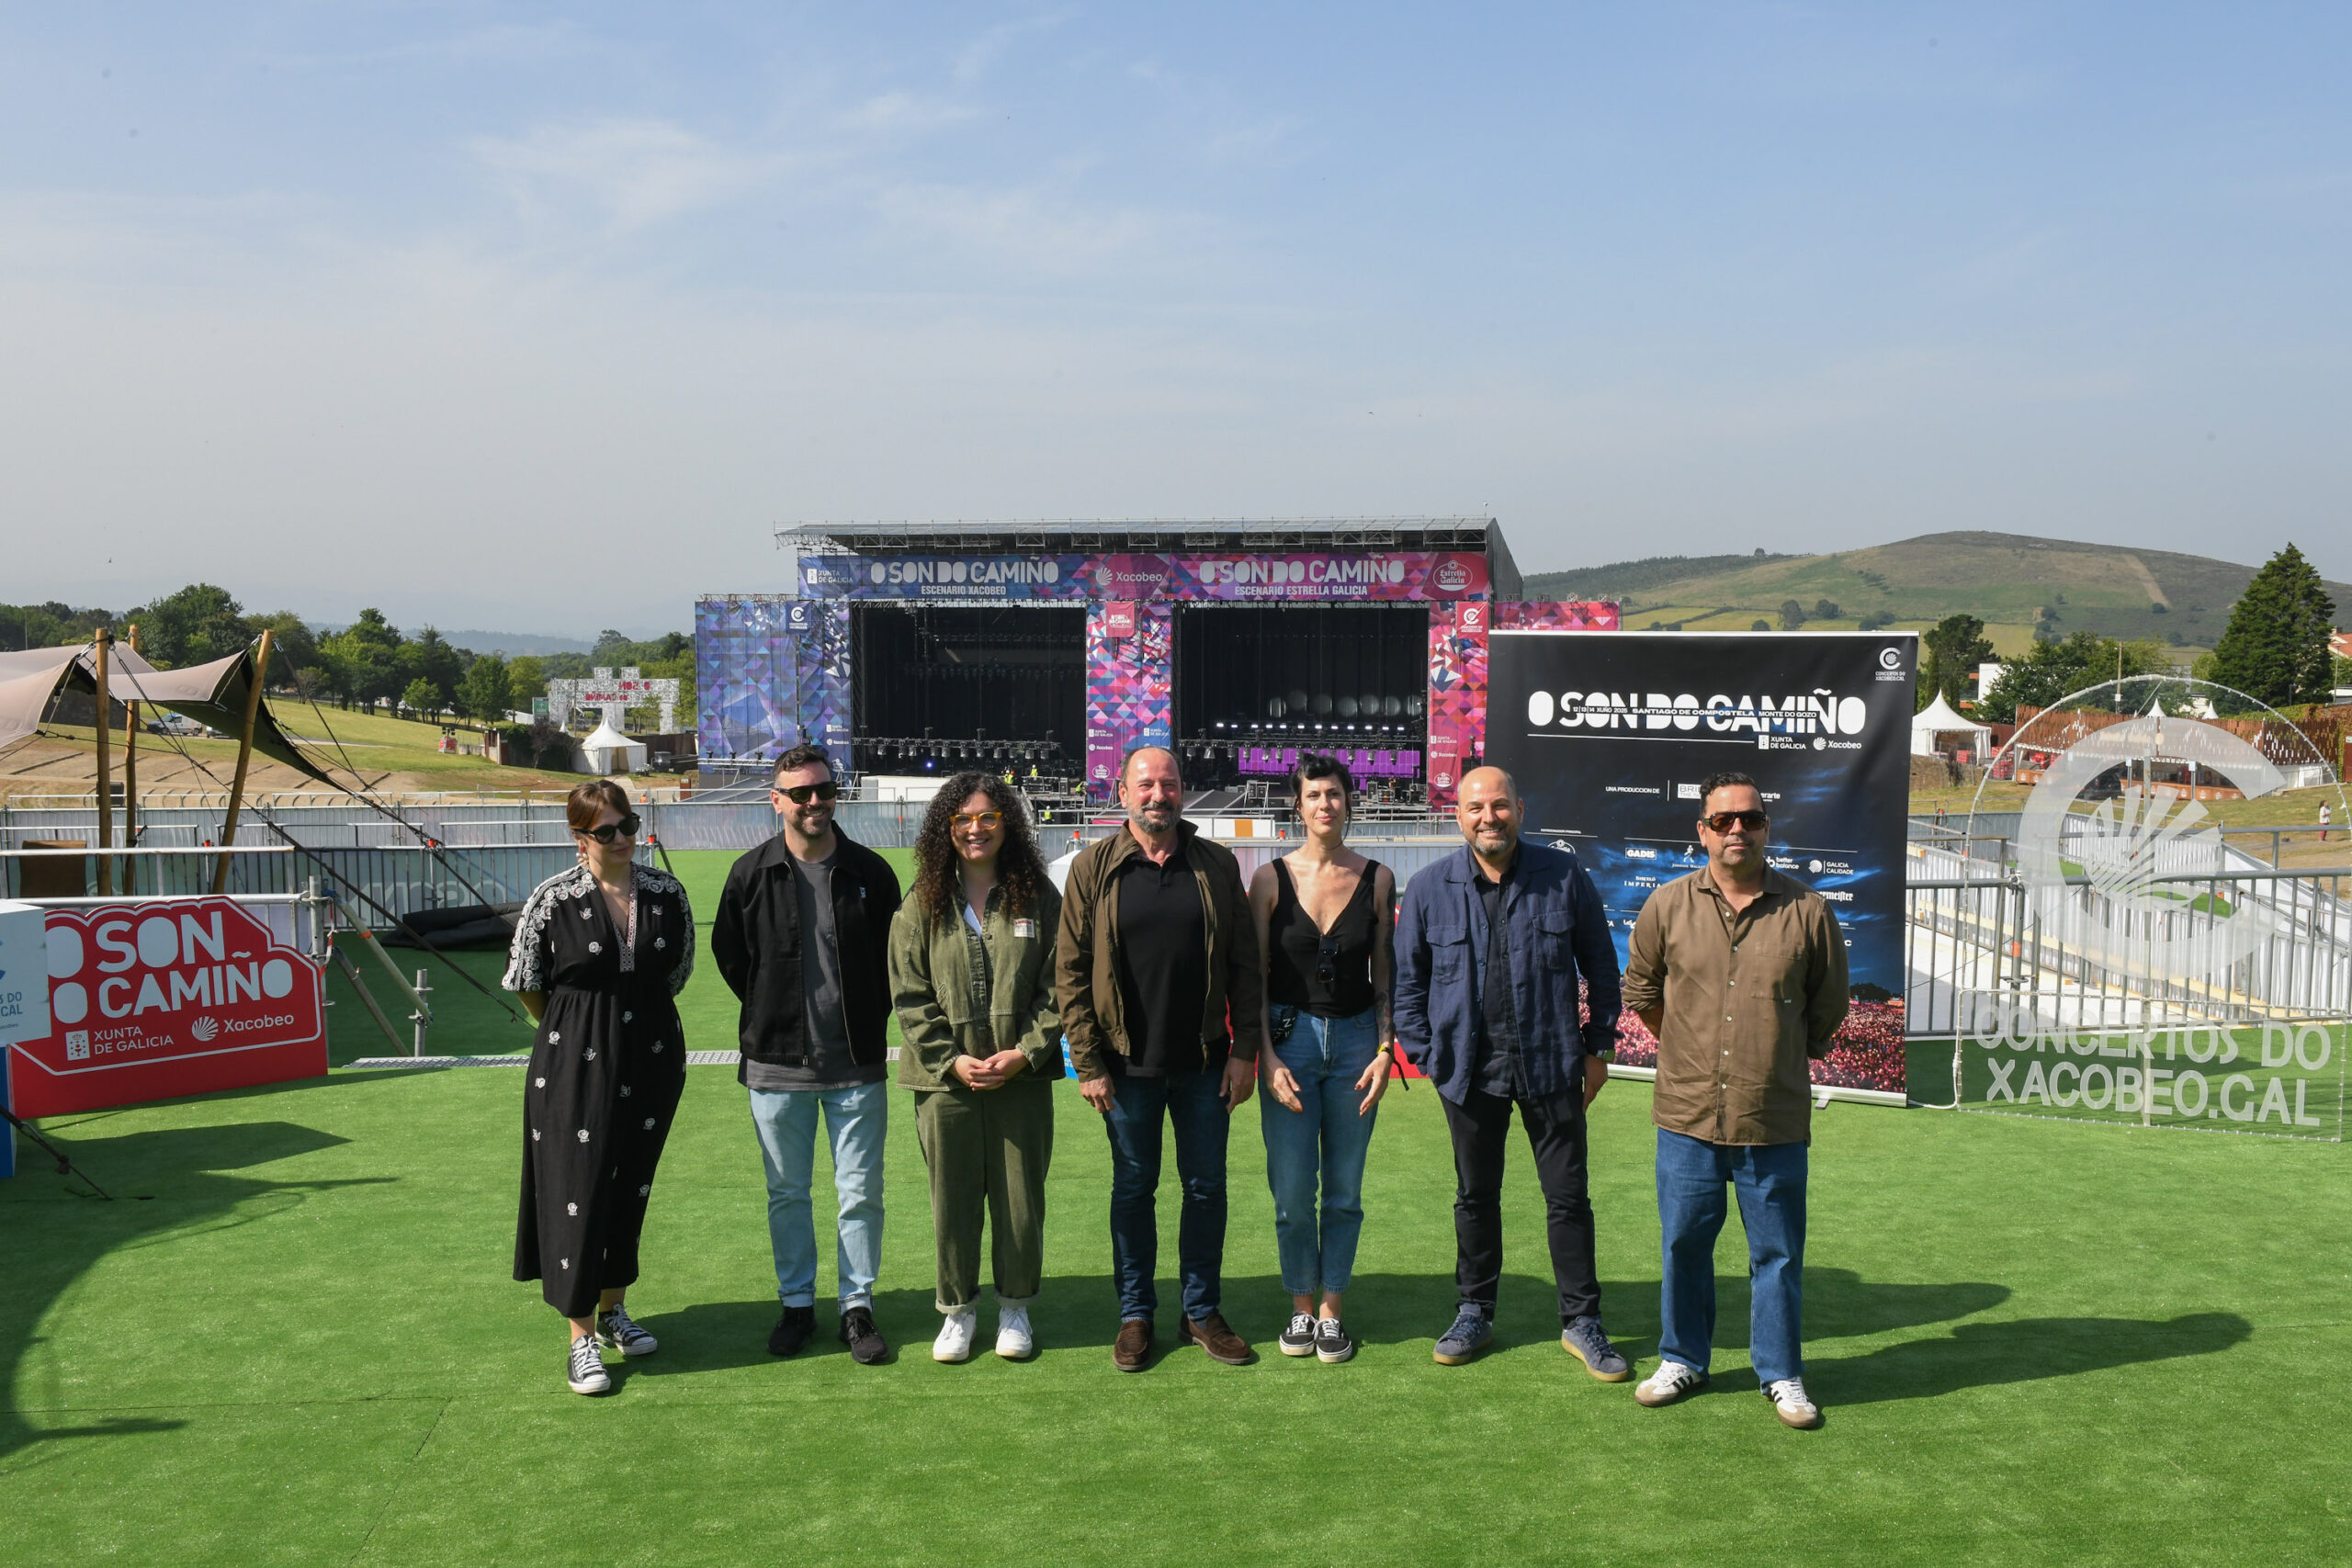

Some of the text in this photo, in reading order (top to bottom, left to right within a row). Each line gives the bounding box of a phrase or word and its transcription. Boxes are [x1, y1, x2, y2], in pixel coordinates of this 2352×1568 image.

[871, 556, 1060, 584] O SON DO CAMIÑO
[1115, 571, 1163, 582] Xacobeo
[1199, 553, 1406, 584] O SON DO CAMIÑO
[1440, 569, 1466, 578] Estrella
[921, 585, 1007, 595] ESCENARIO XACOBEO
[1235, 585, 1368, 596] ESCENARIO ESTRELLA GALICIA
[1528, 688, 1866, 735] O SON DO CAMIÑO
[1827, 739, 1862, 750] Xacobeo
[1626, 849, 1656, 858] GADIS
[1624, 881, 1662, 889] IMPERIA
[46, 911, 227, 978] O SON
[53, 951, 293, 1024] O CAMIÑO
[94, 1026, 143, 1042] XUNTA
[223, 1013, 295, 1034] Xacobeo
[94, 1034, 175, 1055] DE GALICIA
[1973, 1005, 2331, 1071] CONCERTOS DO
[1986, 1057, 2321, 1127] XACOBEO.GAL
